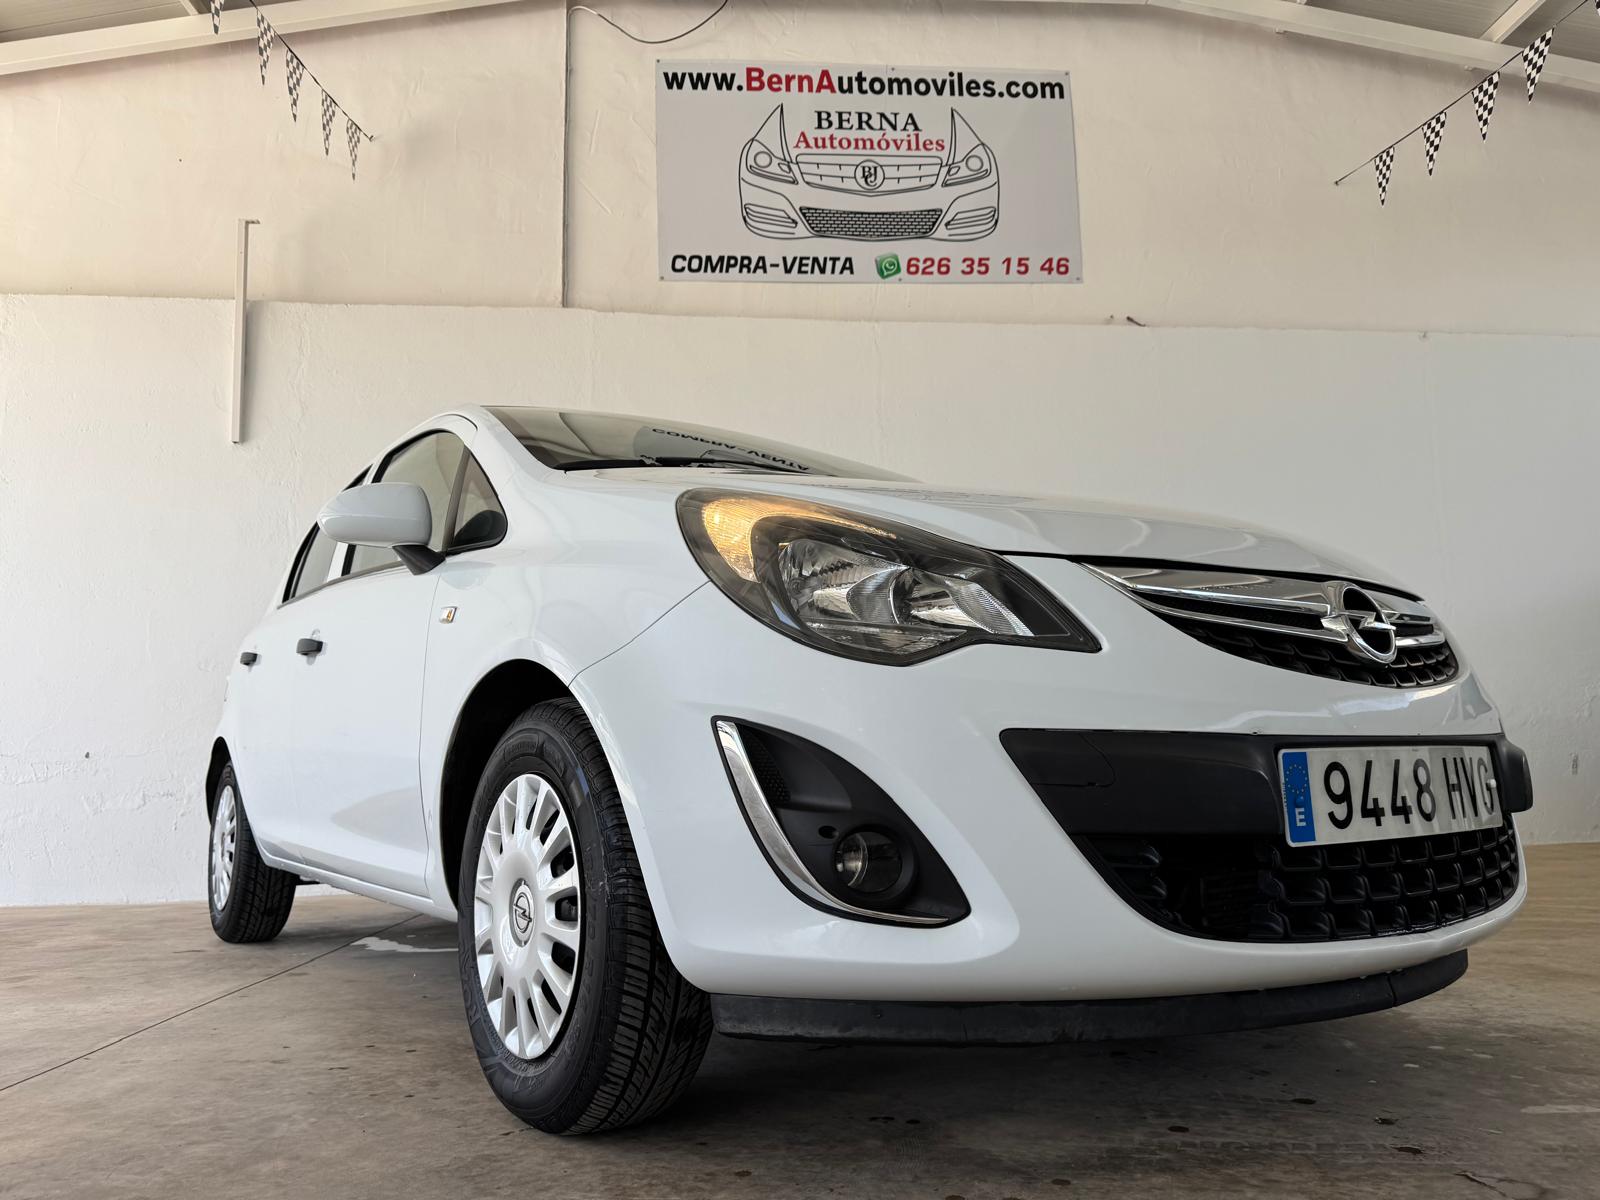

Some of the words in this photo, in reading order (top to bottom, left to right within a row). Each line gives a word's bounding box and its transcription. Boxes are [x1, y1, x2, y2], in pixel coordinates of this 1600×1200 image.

[662, 67, 1066, 99] www.BernAutomoviles.com
[814, 110, 923, 132] BERNA
[793, 130, 945, 152] Automóviles
[671, 254, 855, 276] COMPRA-VENTA
[906, 256, 951, 276] 626
[961, 256, 990, 276] 35
[1001, 256, 1030, 276] 15
[1040, 256, 1070, 276] 46
[1323, 760, 1436, 829] 9448
[1442, 757, 1496, 820] HVG
[1294, 807, 1307, 827] E
